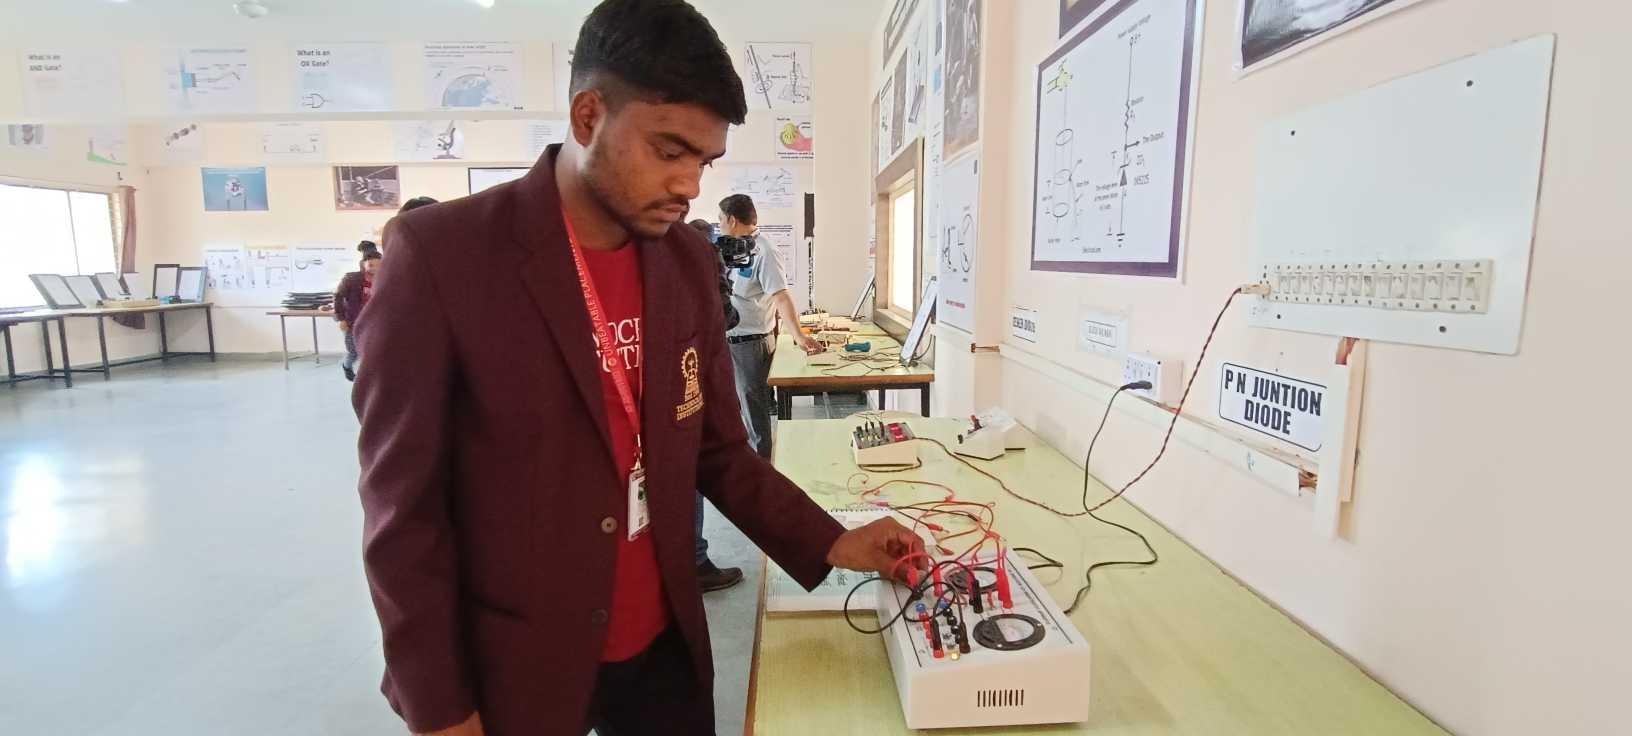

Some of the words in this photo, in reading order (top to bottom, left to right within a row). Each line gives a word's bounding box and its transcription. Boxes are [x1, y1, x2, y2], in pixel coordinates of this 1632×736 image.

[1224, 368, 1234, 390] P
[1236, 372, 1247, 395] N
[1252, 376, 1323, 417] JUNTION
[1244, 399, 1292, 436] DIODE
